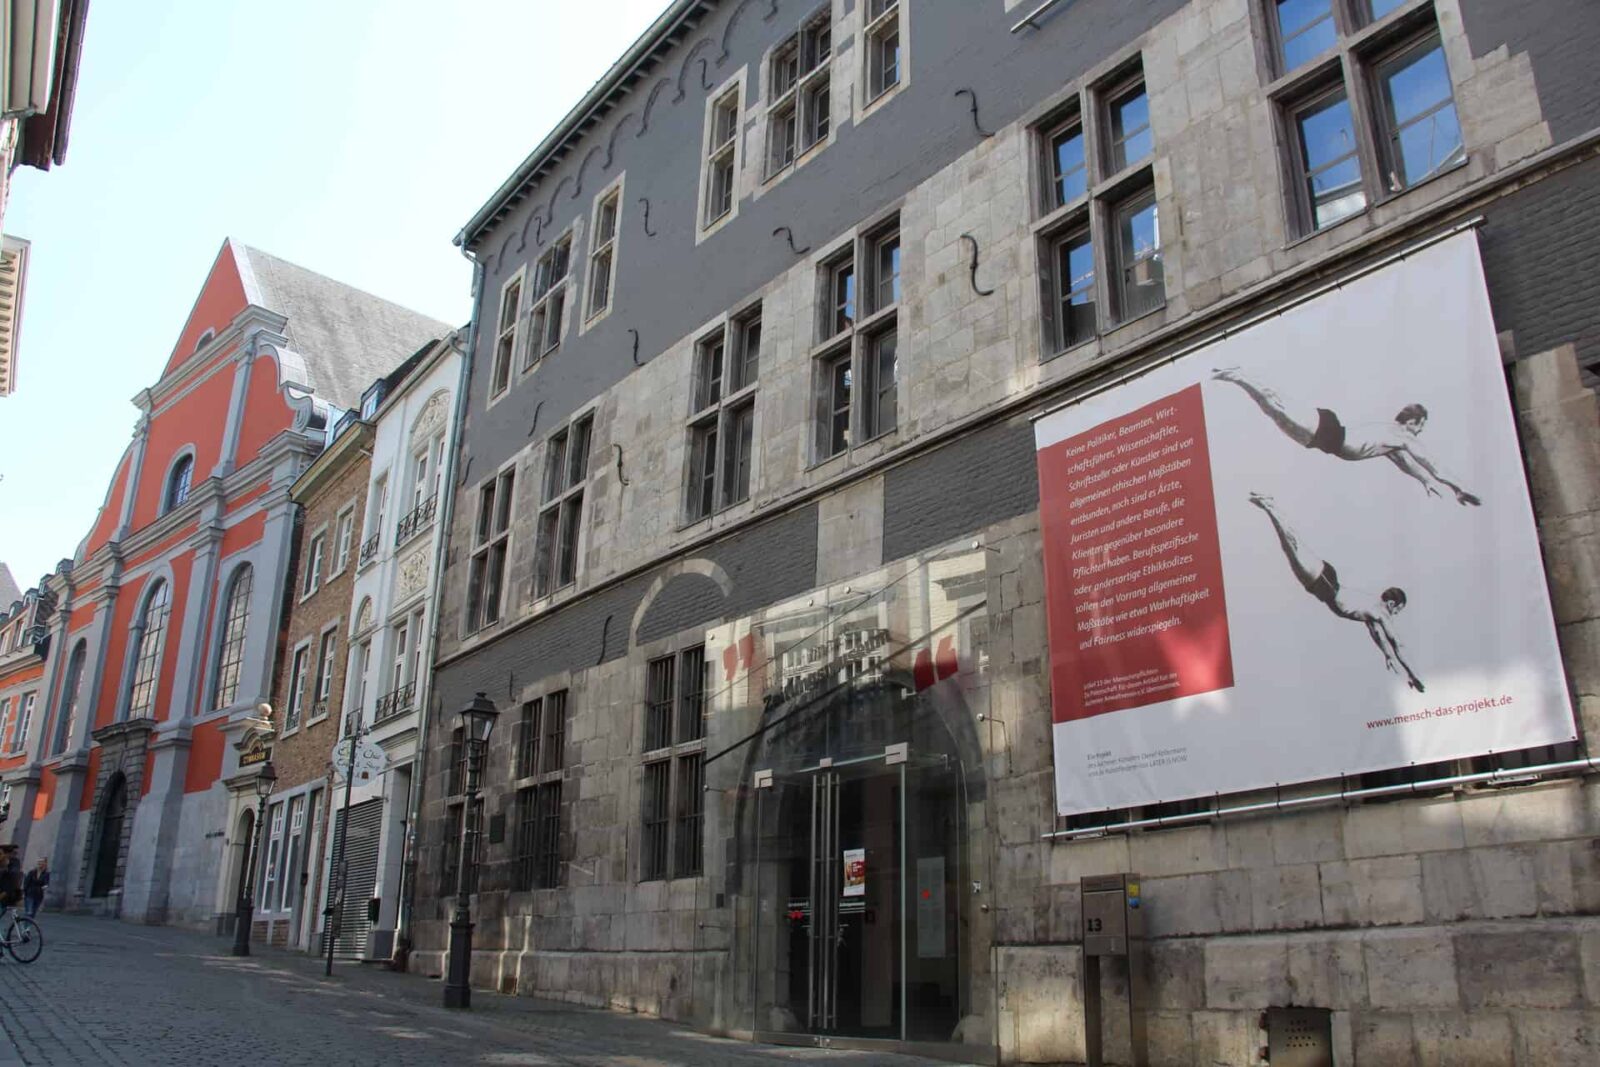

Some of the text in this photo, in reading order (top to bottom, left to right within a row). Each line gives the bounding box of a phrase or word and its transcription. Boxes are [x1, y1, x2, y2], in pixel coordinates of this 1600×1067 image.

[1066, 446, 1085, 457] Keine
[1087, 432, 1116, 448] Politiker,
[1156, 406, 1178, 420] Wirt-
[1117, 426, 1179, 453] Wissenschaftler,
[1069, 438, 1193, 492] Schriftsteller oder Künstler sind von
[1070, 459, 1191, 509] allgemeinen ethischen Maßstäben
[1071, 508, 1111, 526] entbunden,
[1112, 499, 1129, 511] noch
[1130, 490, 1147, 505] sind
[1149, 489, 1156, 498] es
[1071, 498, 1184, 545] Juristen und andere Berufe, die
[1072, 518, 1183, 560] Klienten gegenüber besondere
[1073, 537, 1199, 579] Pflichten haben. Berufsspezifische
[1074, 555, 1193, 596] oder andersartige Ethikkodizes
[1076, 574, 1197, 614] sollen den Vorrang allgemeiner
[1078, 589, 1209, 632] Maßstäbe wie etwa Wahrhaftigkeit
[1080, 616, 1182, 650] und Fairness widerspiegeln.
[1366, 695, 1512, 729] www.mensch-das-projekt.de
[1088, 918, 1102, 932] 13
